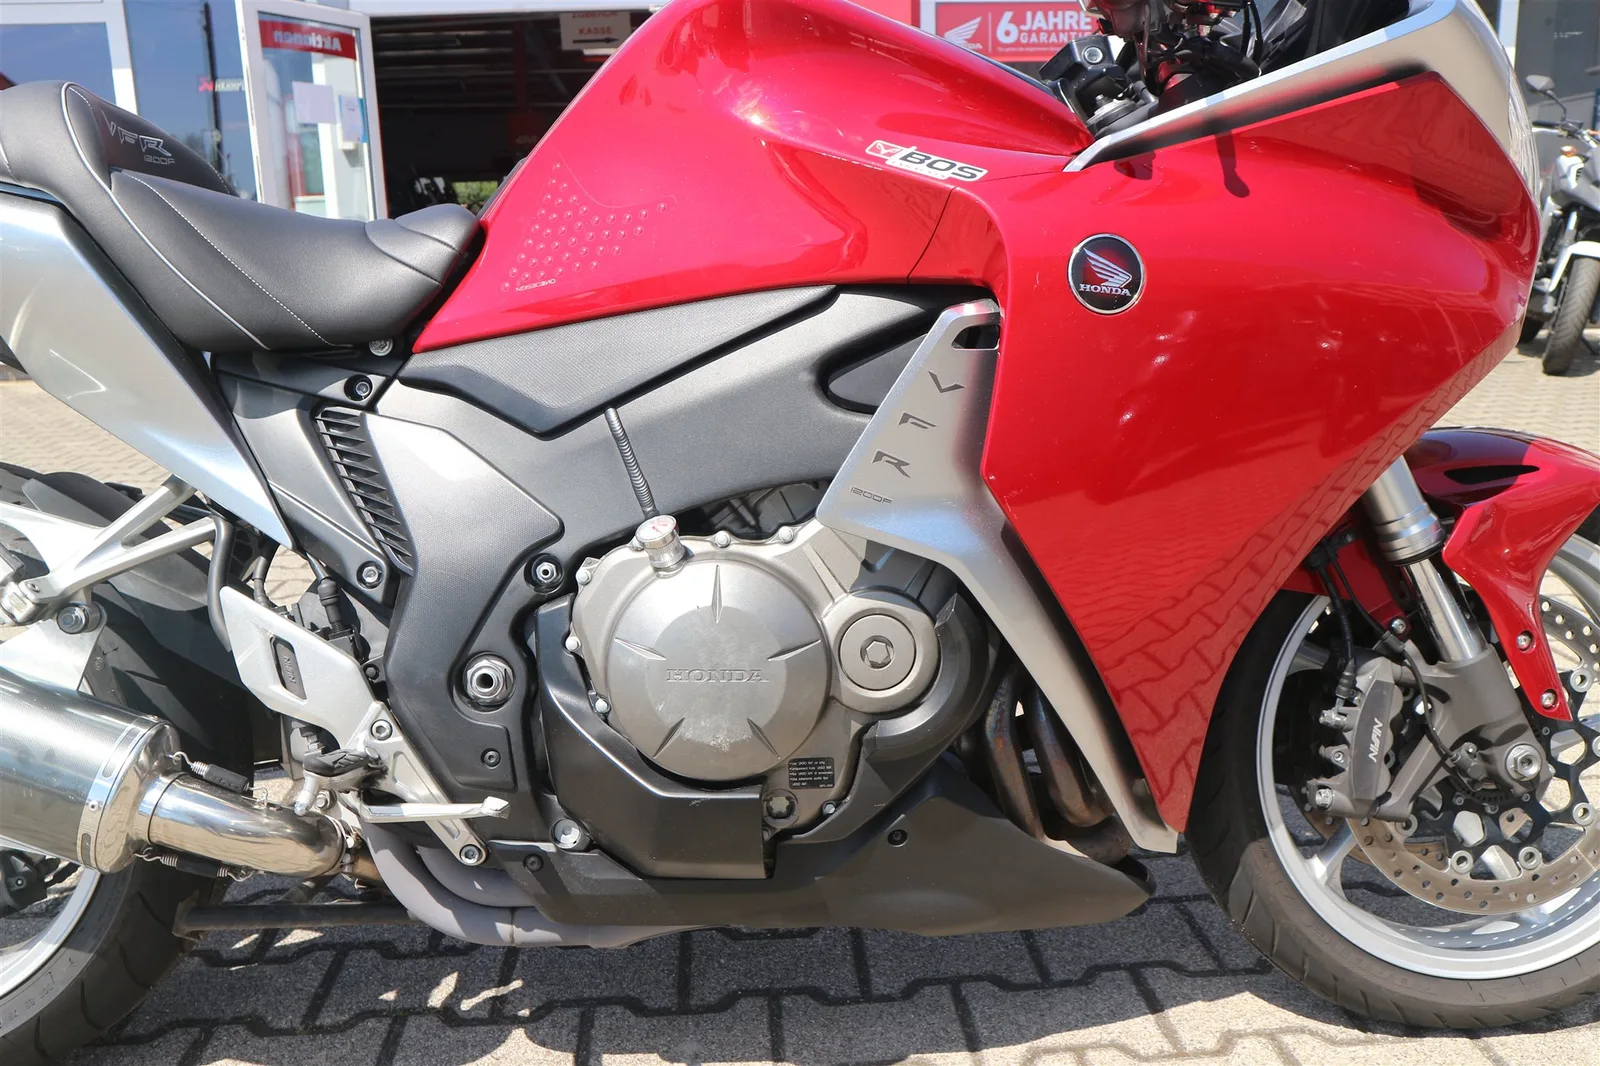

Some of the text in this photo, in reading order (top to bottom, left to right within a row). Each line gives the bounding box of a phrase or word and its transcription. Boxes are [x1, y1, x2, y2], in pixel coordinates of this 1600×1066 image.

[578, 26, 613, 35] KASSE
[996, 10, 1092, 44] 6 JAHRE
[898, 151, 984, 180] BOS
[1079, 283, 1132, 297] HONDA
[850, 486, 893, 504] 1200F
[666, 668, 770, 683] HONDA
